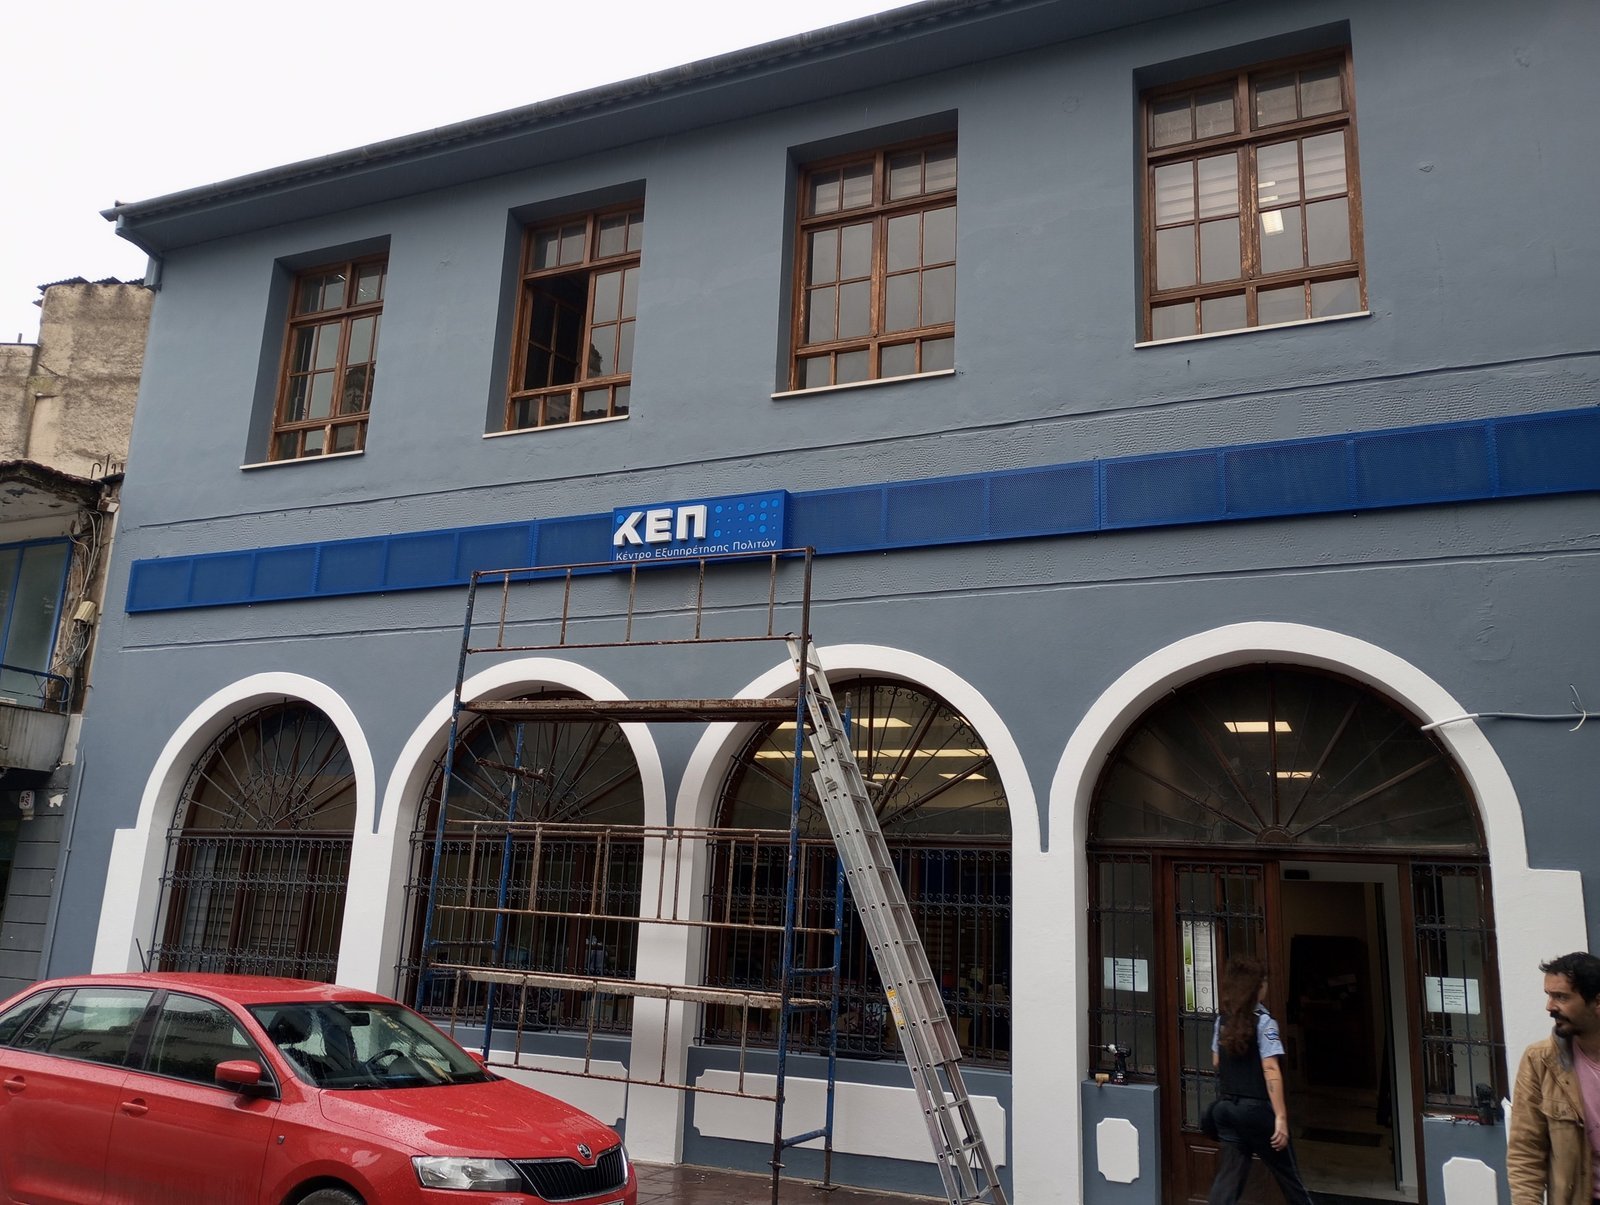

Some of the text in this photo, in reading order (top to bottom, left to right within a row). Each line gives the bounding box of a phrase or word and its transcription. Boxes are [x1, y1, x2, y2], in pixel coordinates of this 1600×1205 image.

[613, 504, 708, 547] ΚΕΠ
[616, 538, 777, 561] Κέντρο Εξυπηρέτησης Πολιτών
